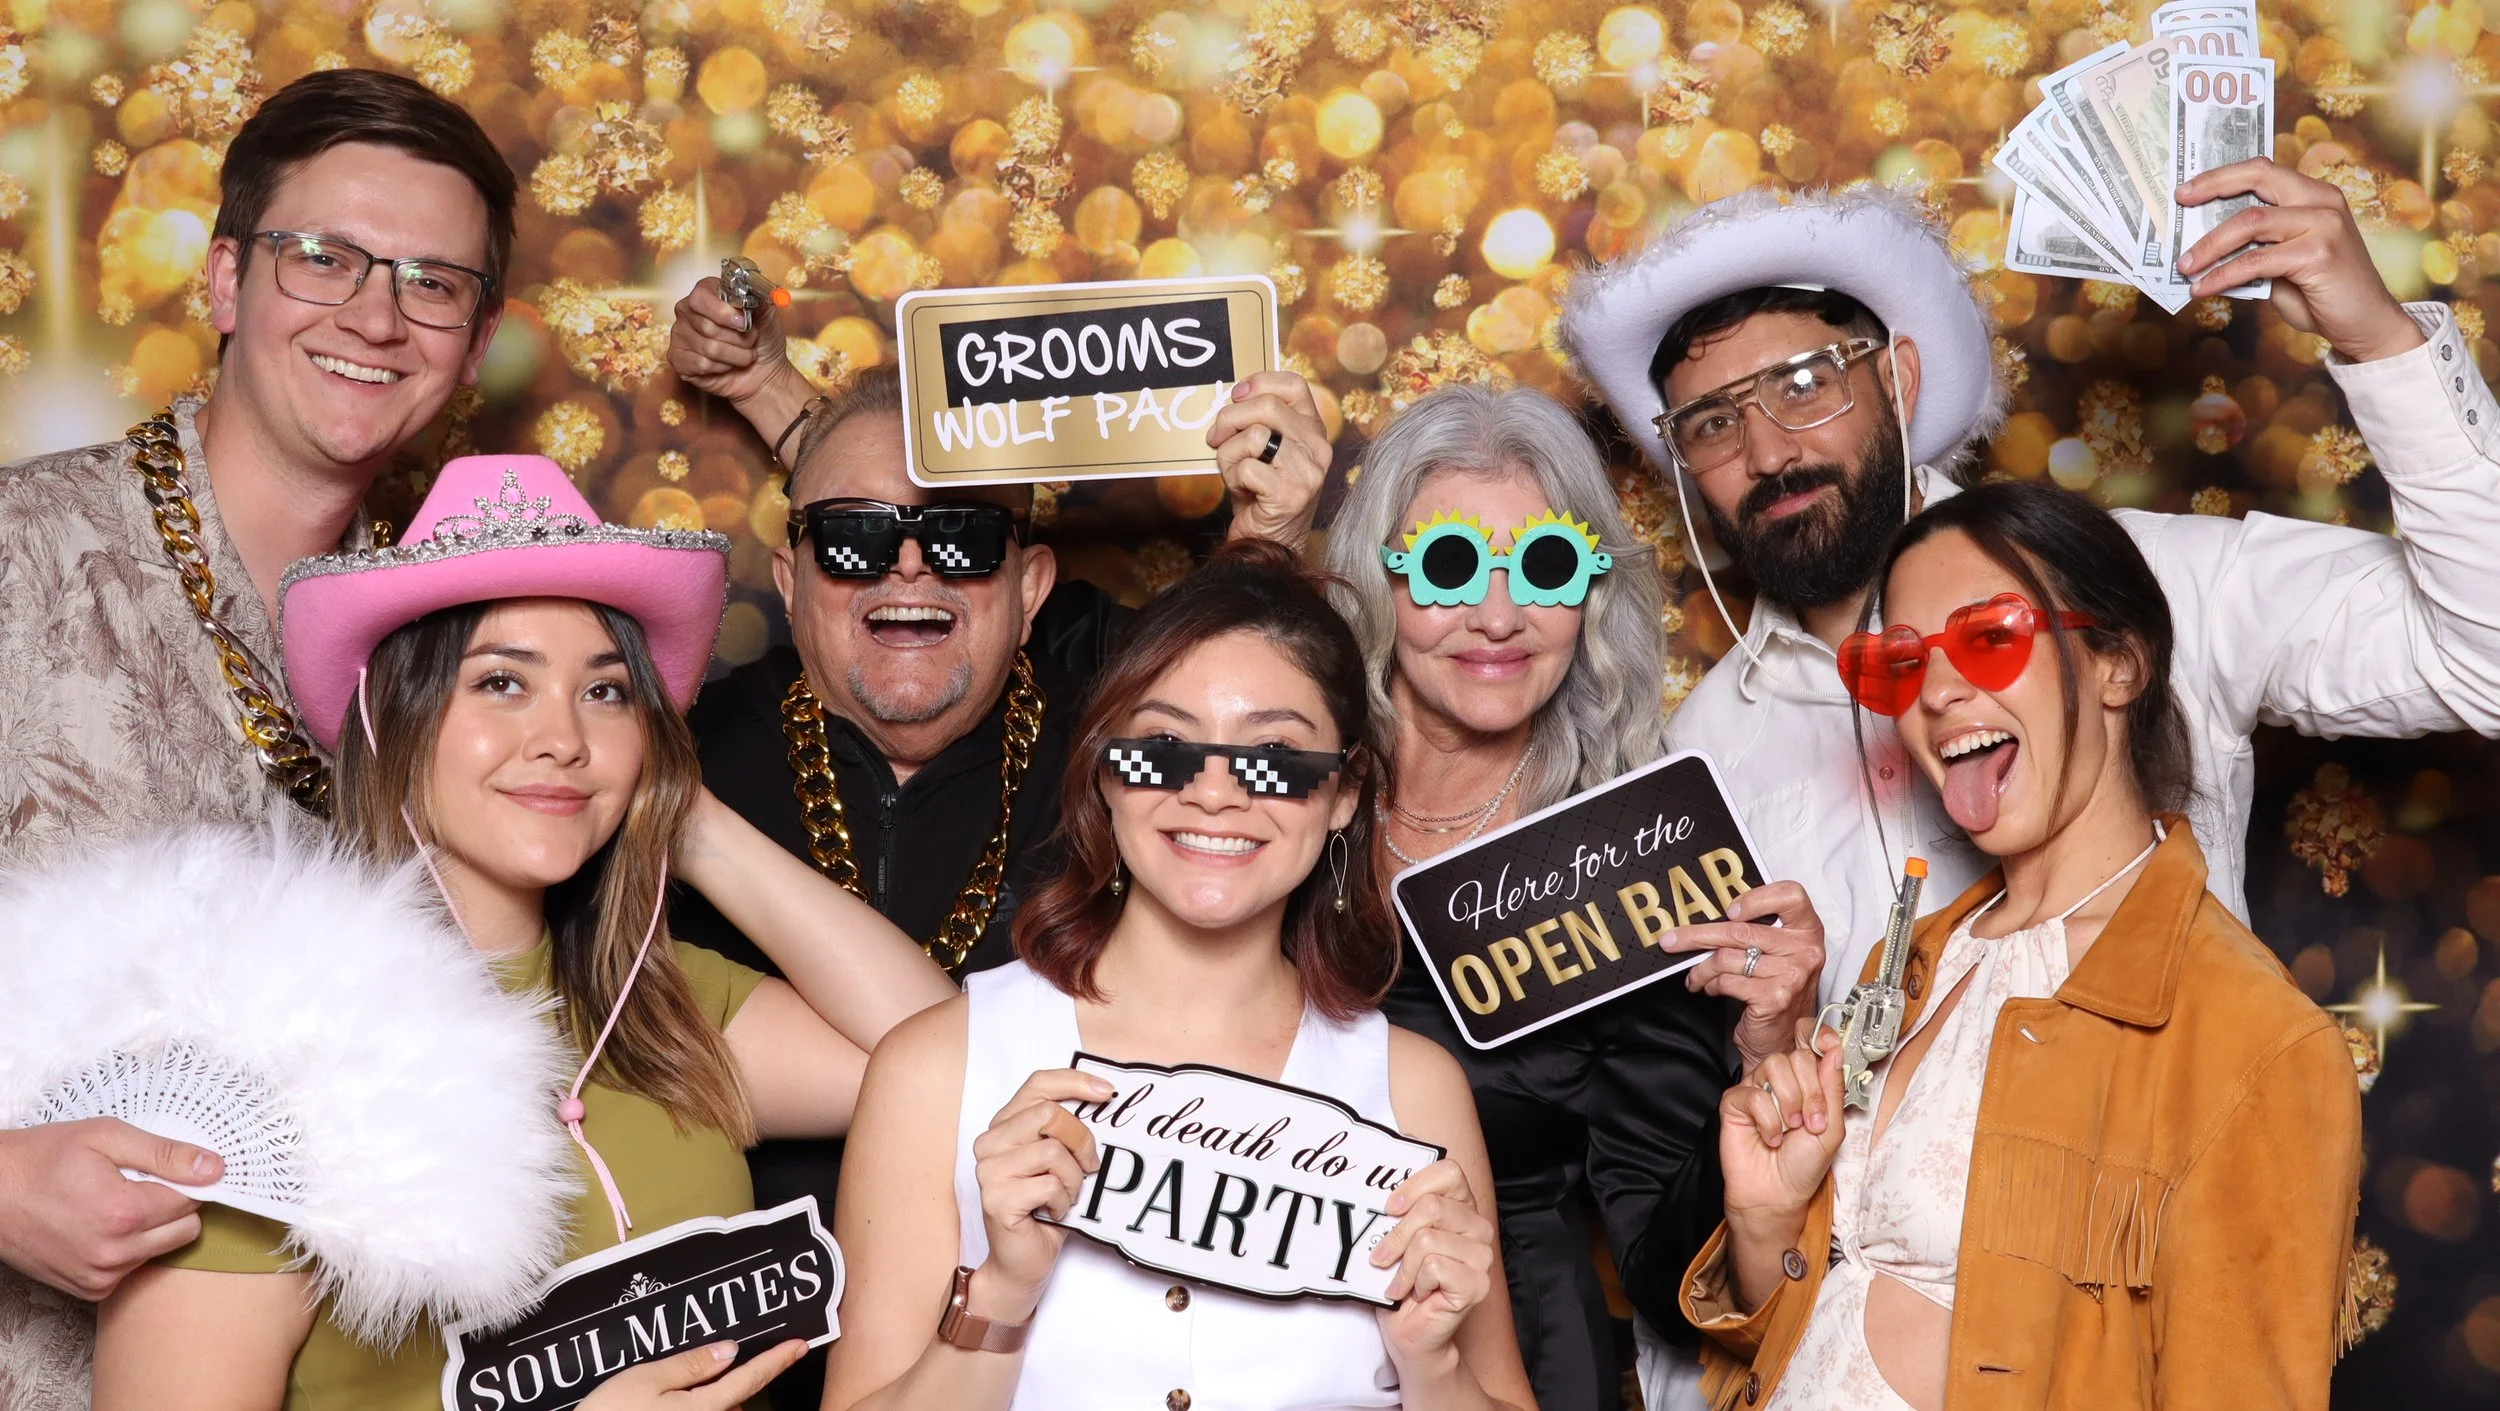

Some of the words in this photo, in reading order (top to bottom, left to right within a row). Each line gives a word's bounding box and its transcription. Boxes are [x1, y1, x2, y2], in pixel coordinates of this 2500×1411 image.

[2185, 69, 2257, 106] 100
[2093, 157, 2105, 173] ONE
[2102, 172, 2124, 208] HUNDRED
[2069, 210, 2082, 224] ONE
[2082, 221, 2112, 250] HUNDRED
[956, 317, 1217, 387] GROOMS
[933, 396, 1072, 453] WOLF
[1447, 861, 1564, 932] Here
[1564, 842, 1630, 901] for
[1634, 813, 1696, 857] the
[1450, 901, 1622, 1016] OPEN
[1616, 846, 1752, 949] BAR
[1145, 1096, 1291, 1163] death
[1291, 1131, 1357, 1178] do
[1080, 1142, 1388, 1284] PARTY
[469, 1249, 823, 1411] SOULMATES
